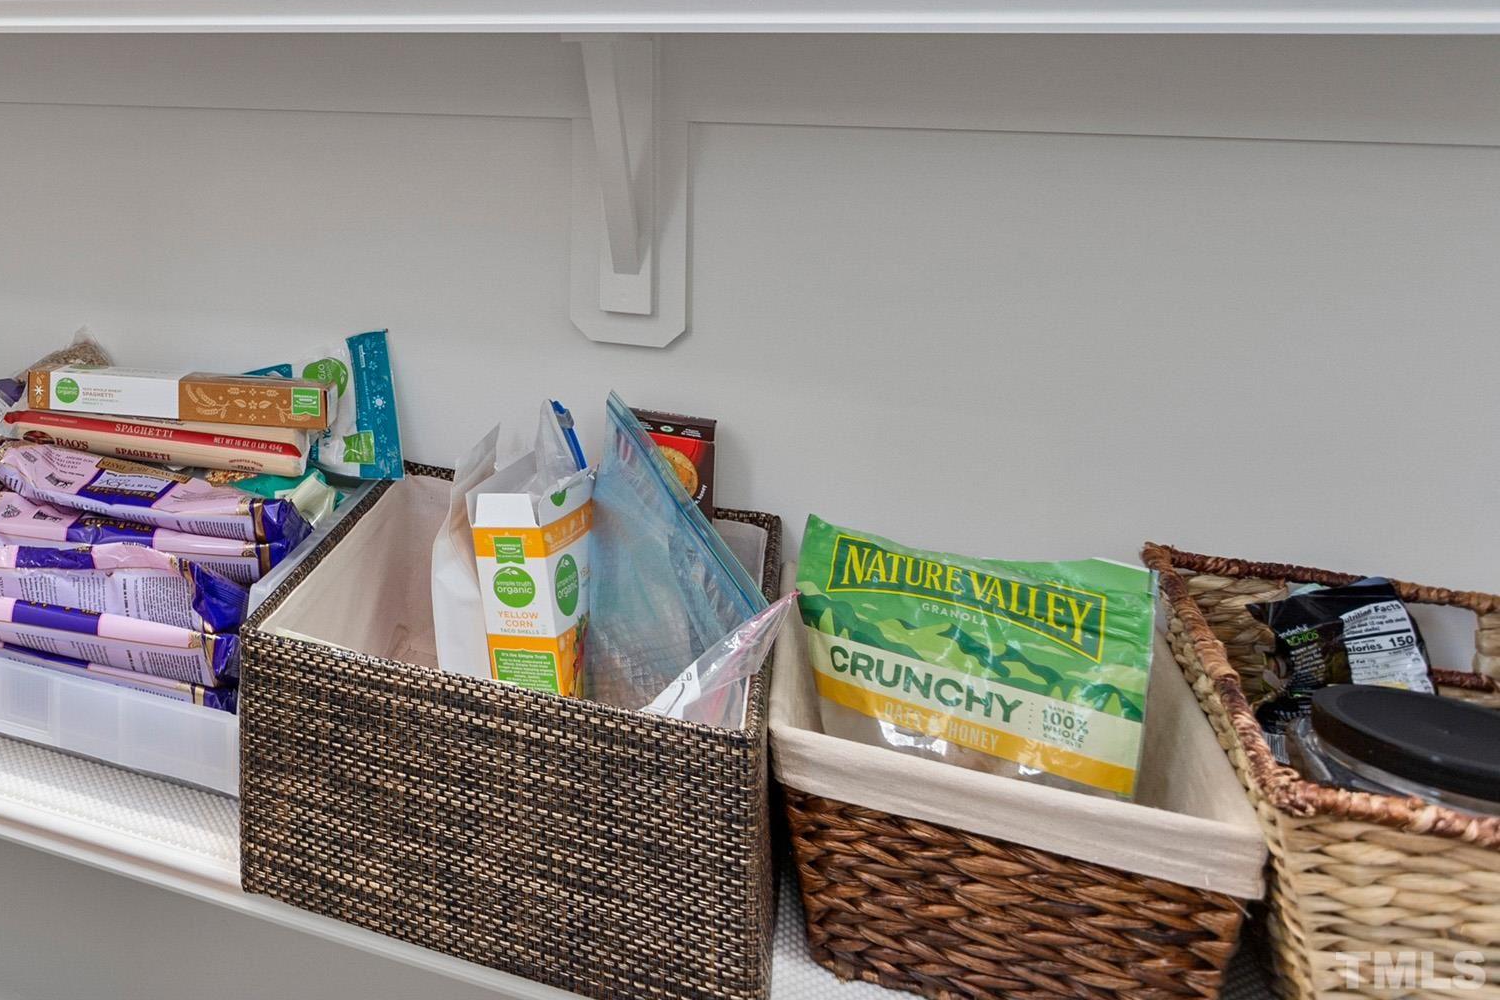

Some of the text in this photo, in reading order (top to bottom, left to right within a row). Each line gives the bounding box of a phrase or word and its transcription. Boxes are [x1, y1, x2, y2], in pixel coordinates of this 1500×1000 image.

[81, 391, 114, 399] SPAGHETTI
[114, 423, 174, 440] SPAGHETTI
[55, 437, 90, 451] RAO'S
[213, 436, 225, 445] NET
[225, 437, 234, 446] WT
[268, 442, 283, 453] 454g
[114, 446, 172, 462] SPAGHETTI
[496, 585, 534, 596] organic
[840, 543, 1093, 646] NATURE VALLEY
[497, 610, 539, 620] YELLOW
[921, 601, 989, 627] GRANOLA
[1344, 602, 1402, 624] utrition Facts
[504, 619, 534, 629] CORN
[1347, 636, 1415, 656] alories 150
[829, 644, 1024, 724] CRUNCHY
[884, 703, 1000, 752] OATS HONEY
[1041, 708, 1089, 736] 100%
[1043, 726, 1085, 743] WHOLE
